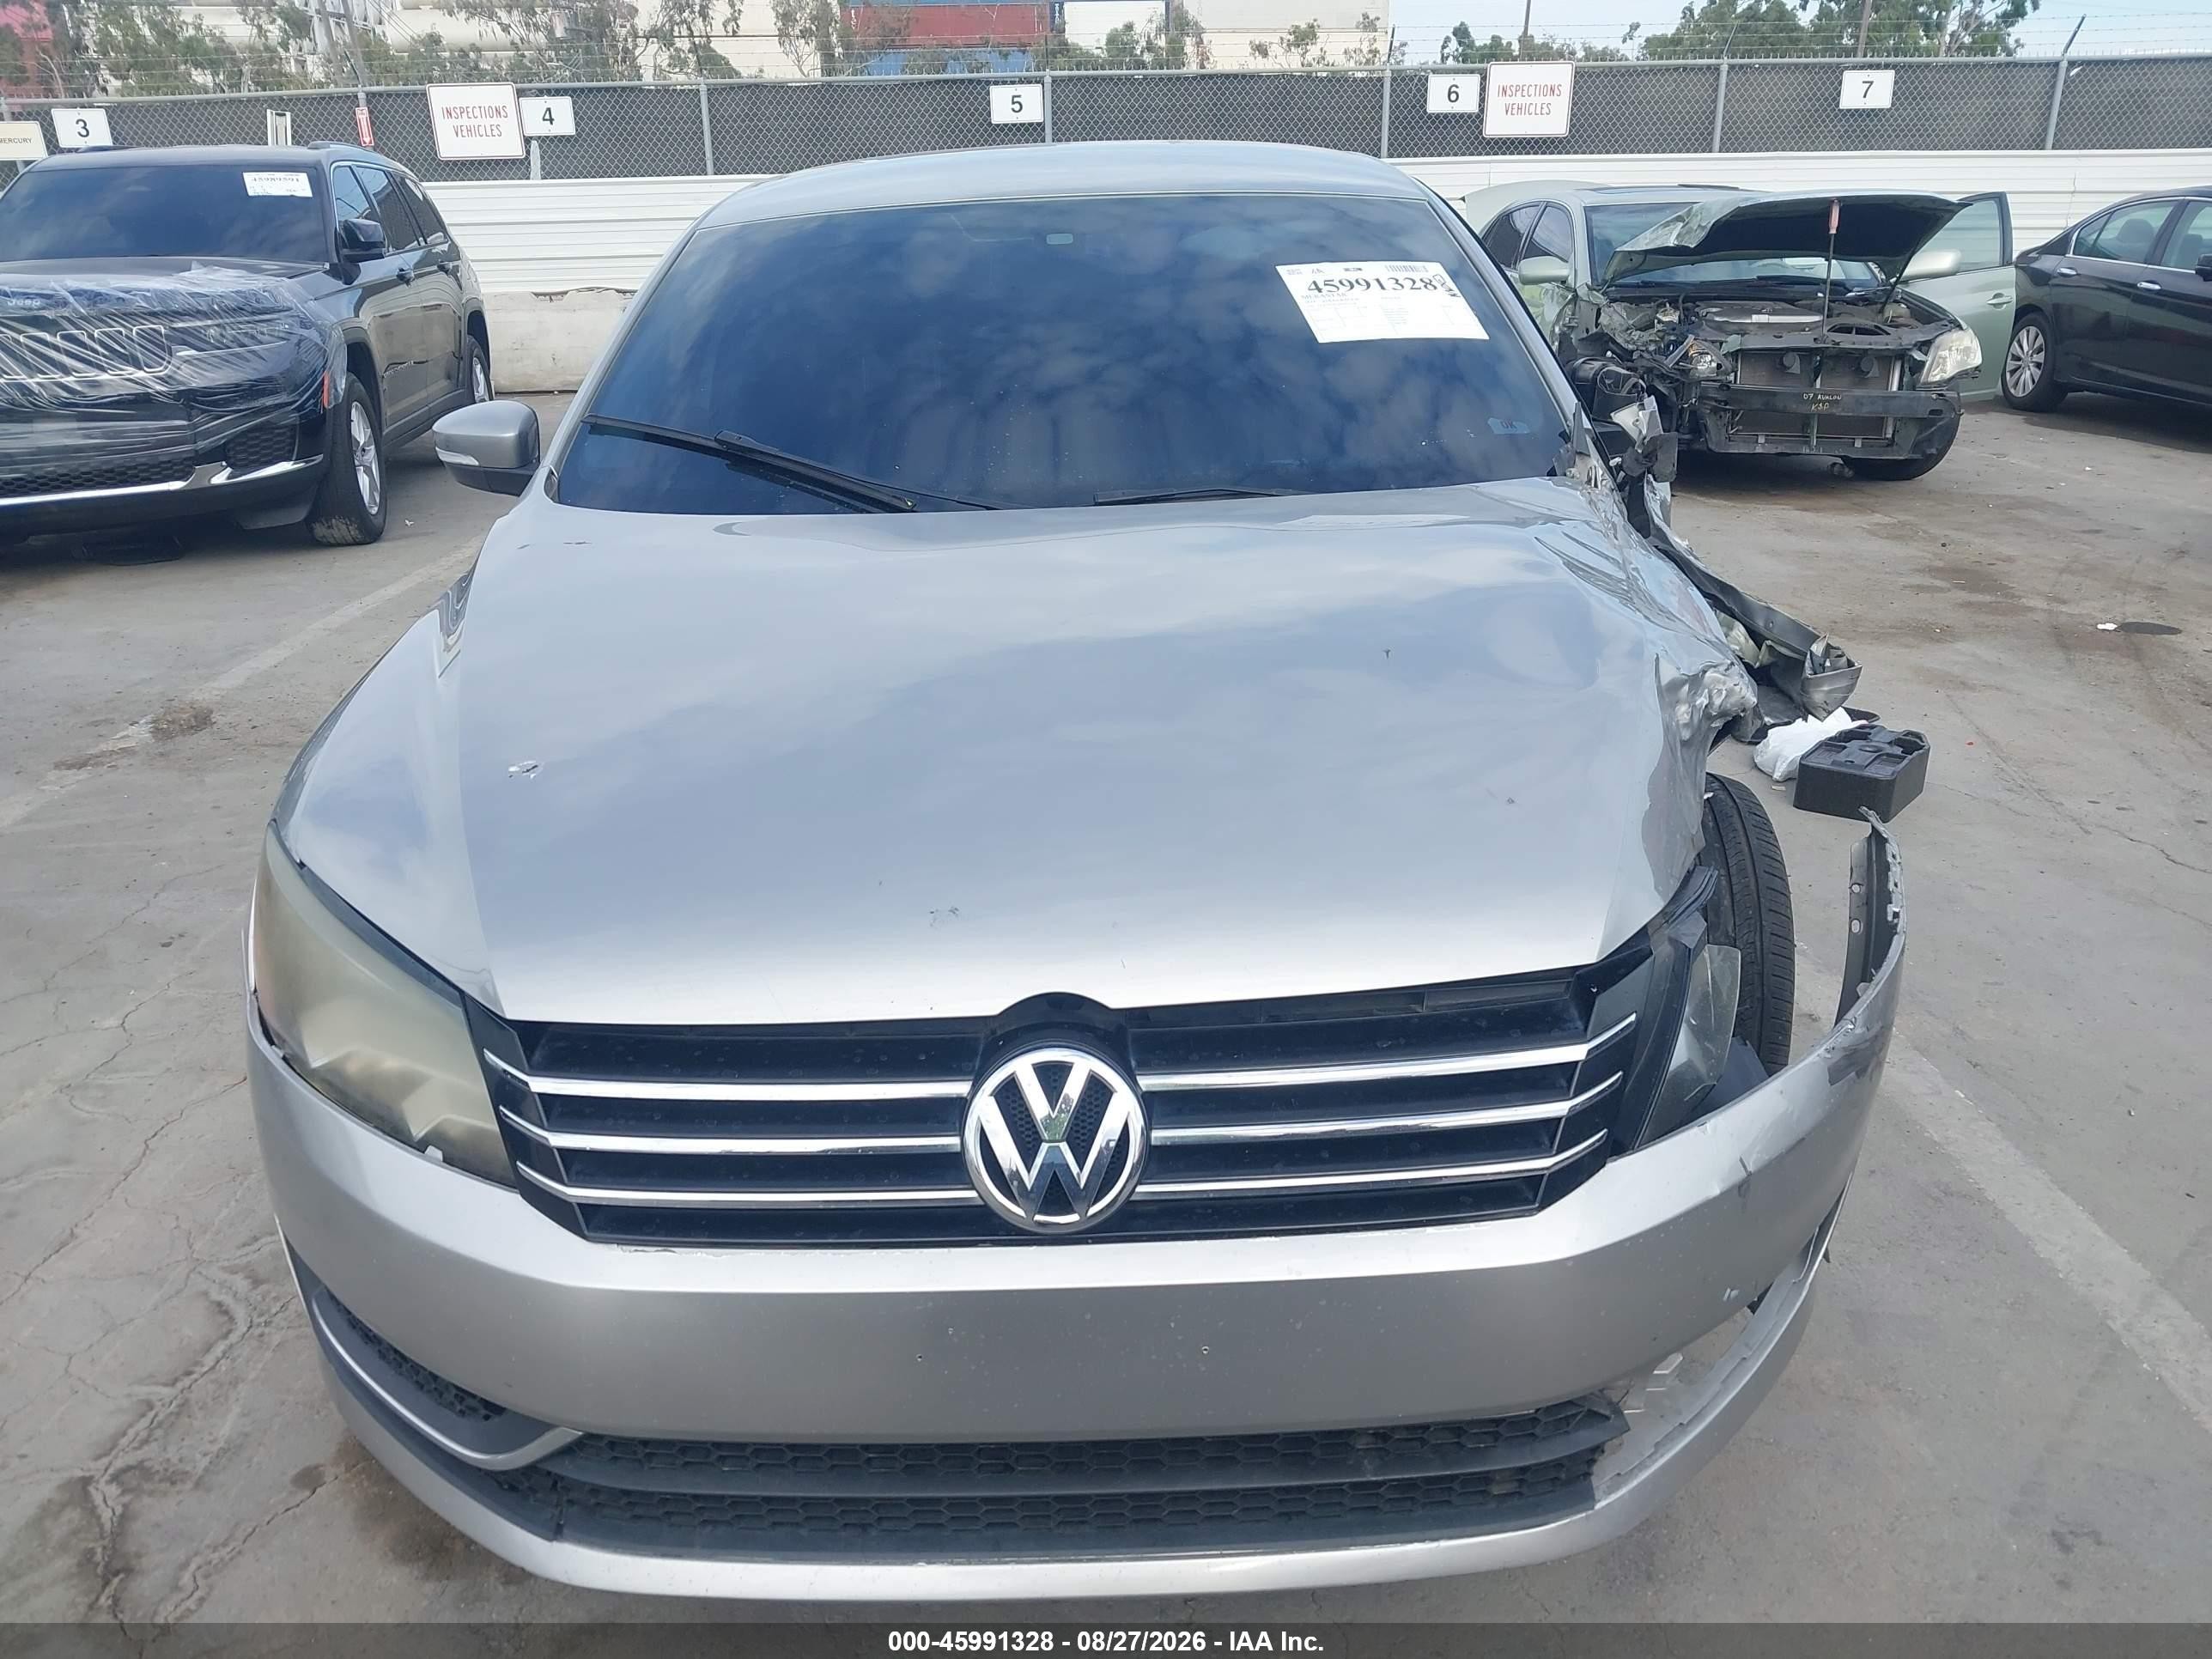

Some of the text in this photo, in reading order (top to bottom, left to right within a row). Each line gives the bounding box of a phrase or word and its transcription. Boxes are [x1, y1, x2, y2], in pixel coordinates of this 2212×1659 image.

[1447, 83, 1460, 103] 6
[1498, 83, 1562, 98] INSPECTIONS
[1862, 80, 1875, 99] 7
[441, 105, 509, 120] INSPECTIONS
[1011, 94, 1024, 113] 5
[1504, 102, 1552, 116] VEHICLES
[541, 108, 556, 126] 4
[75, 118, 90, 138] 3
[453, 124, 503, 138] VEHICLES
[1307, 276, 1438, 294] 45991328
